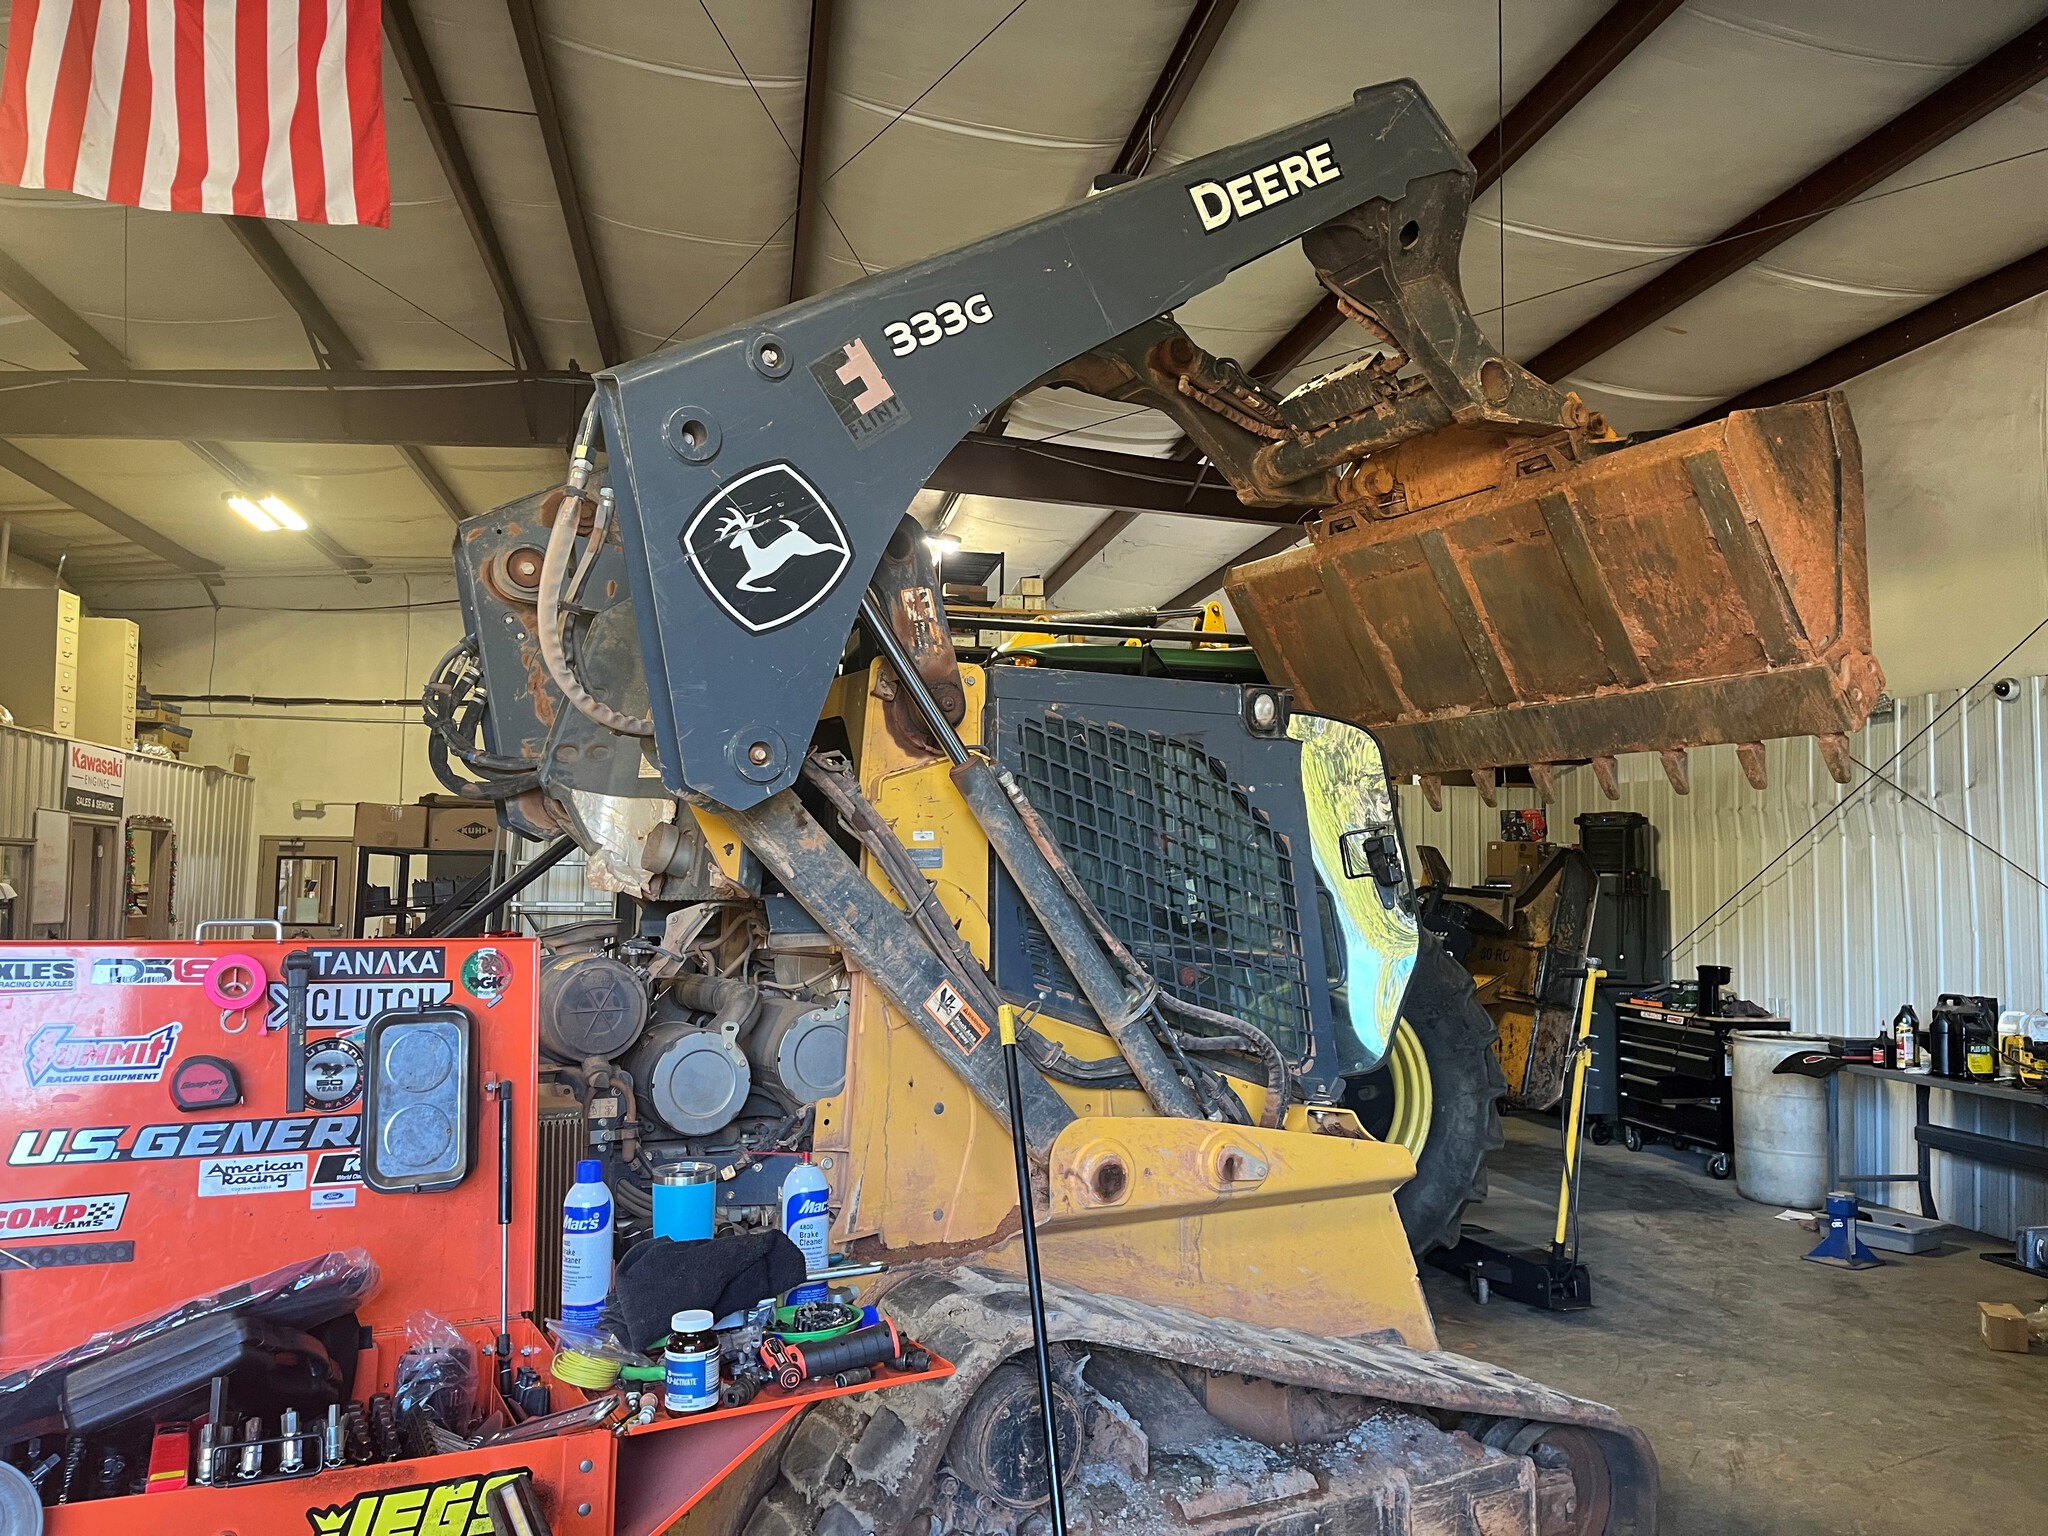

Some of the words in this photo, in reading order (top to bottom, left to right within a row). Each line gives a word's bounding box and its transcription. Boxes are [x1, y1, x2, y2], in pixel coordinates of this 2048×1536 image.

[1189, 142, 1341, 231] DEERE
[883, 292, 994, 358] 333G
[846, 396, 901, 441] FLINT
[72, 746, 123, 778] Kawasaki
[84, 774, 110, 790] ENGINES
[75, 796, 92, 808] SALES
[95, 799, 115, 812] SERVICE
[461, 826, 489, 835] KUHN
[313, 950, 439, 975] TANAKA
[46, 980, 74, 988] AXLES
[305, 1041, 364, 1068] USTANG
[46, 1074, 90, 1083] RACING
[92, 1073, 159, 1082] EQUIPMENT
[180, 1079, 223, 1090] Snap-on
[131, 1116, 361, 1159] GENER
[208, 1160, 304, 1175] American
[221, 1173, 288, 1188] Racing
[53, 1219, 104, 1230] CAMS
[563, 1214, 600, 1231] Mac's
[799, 1231, 819, 1239] Brake
[799, 1238, 823, 1247] Cleaner
